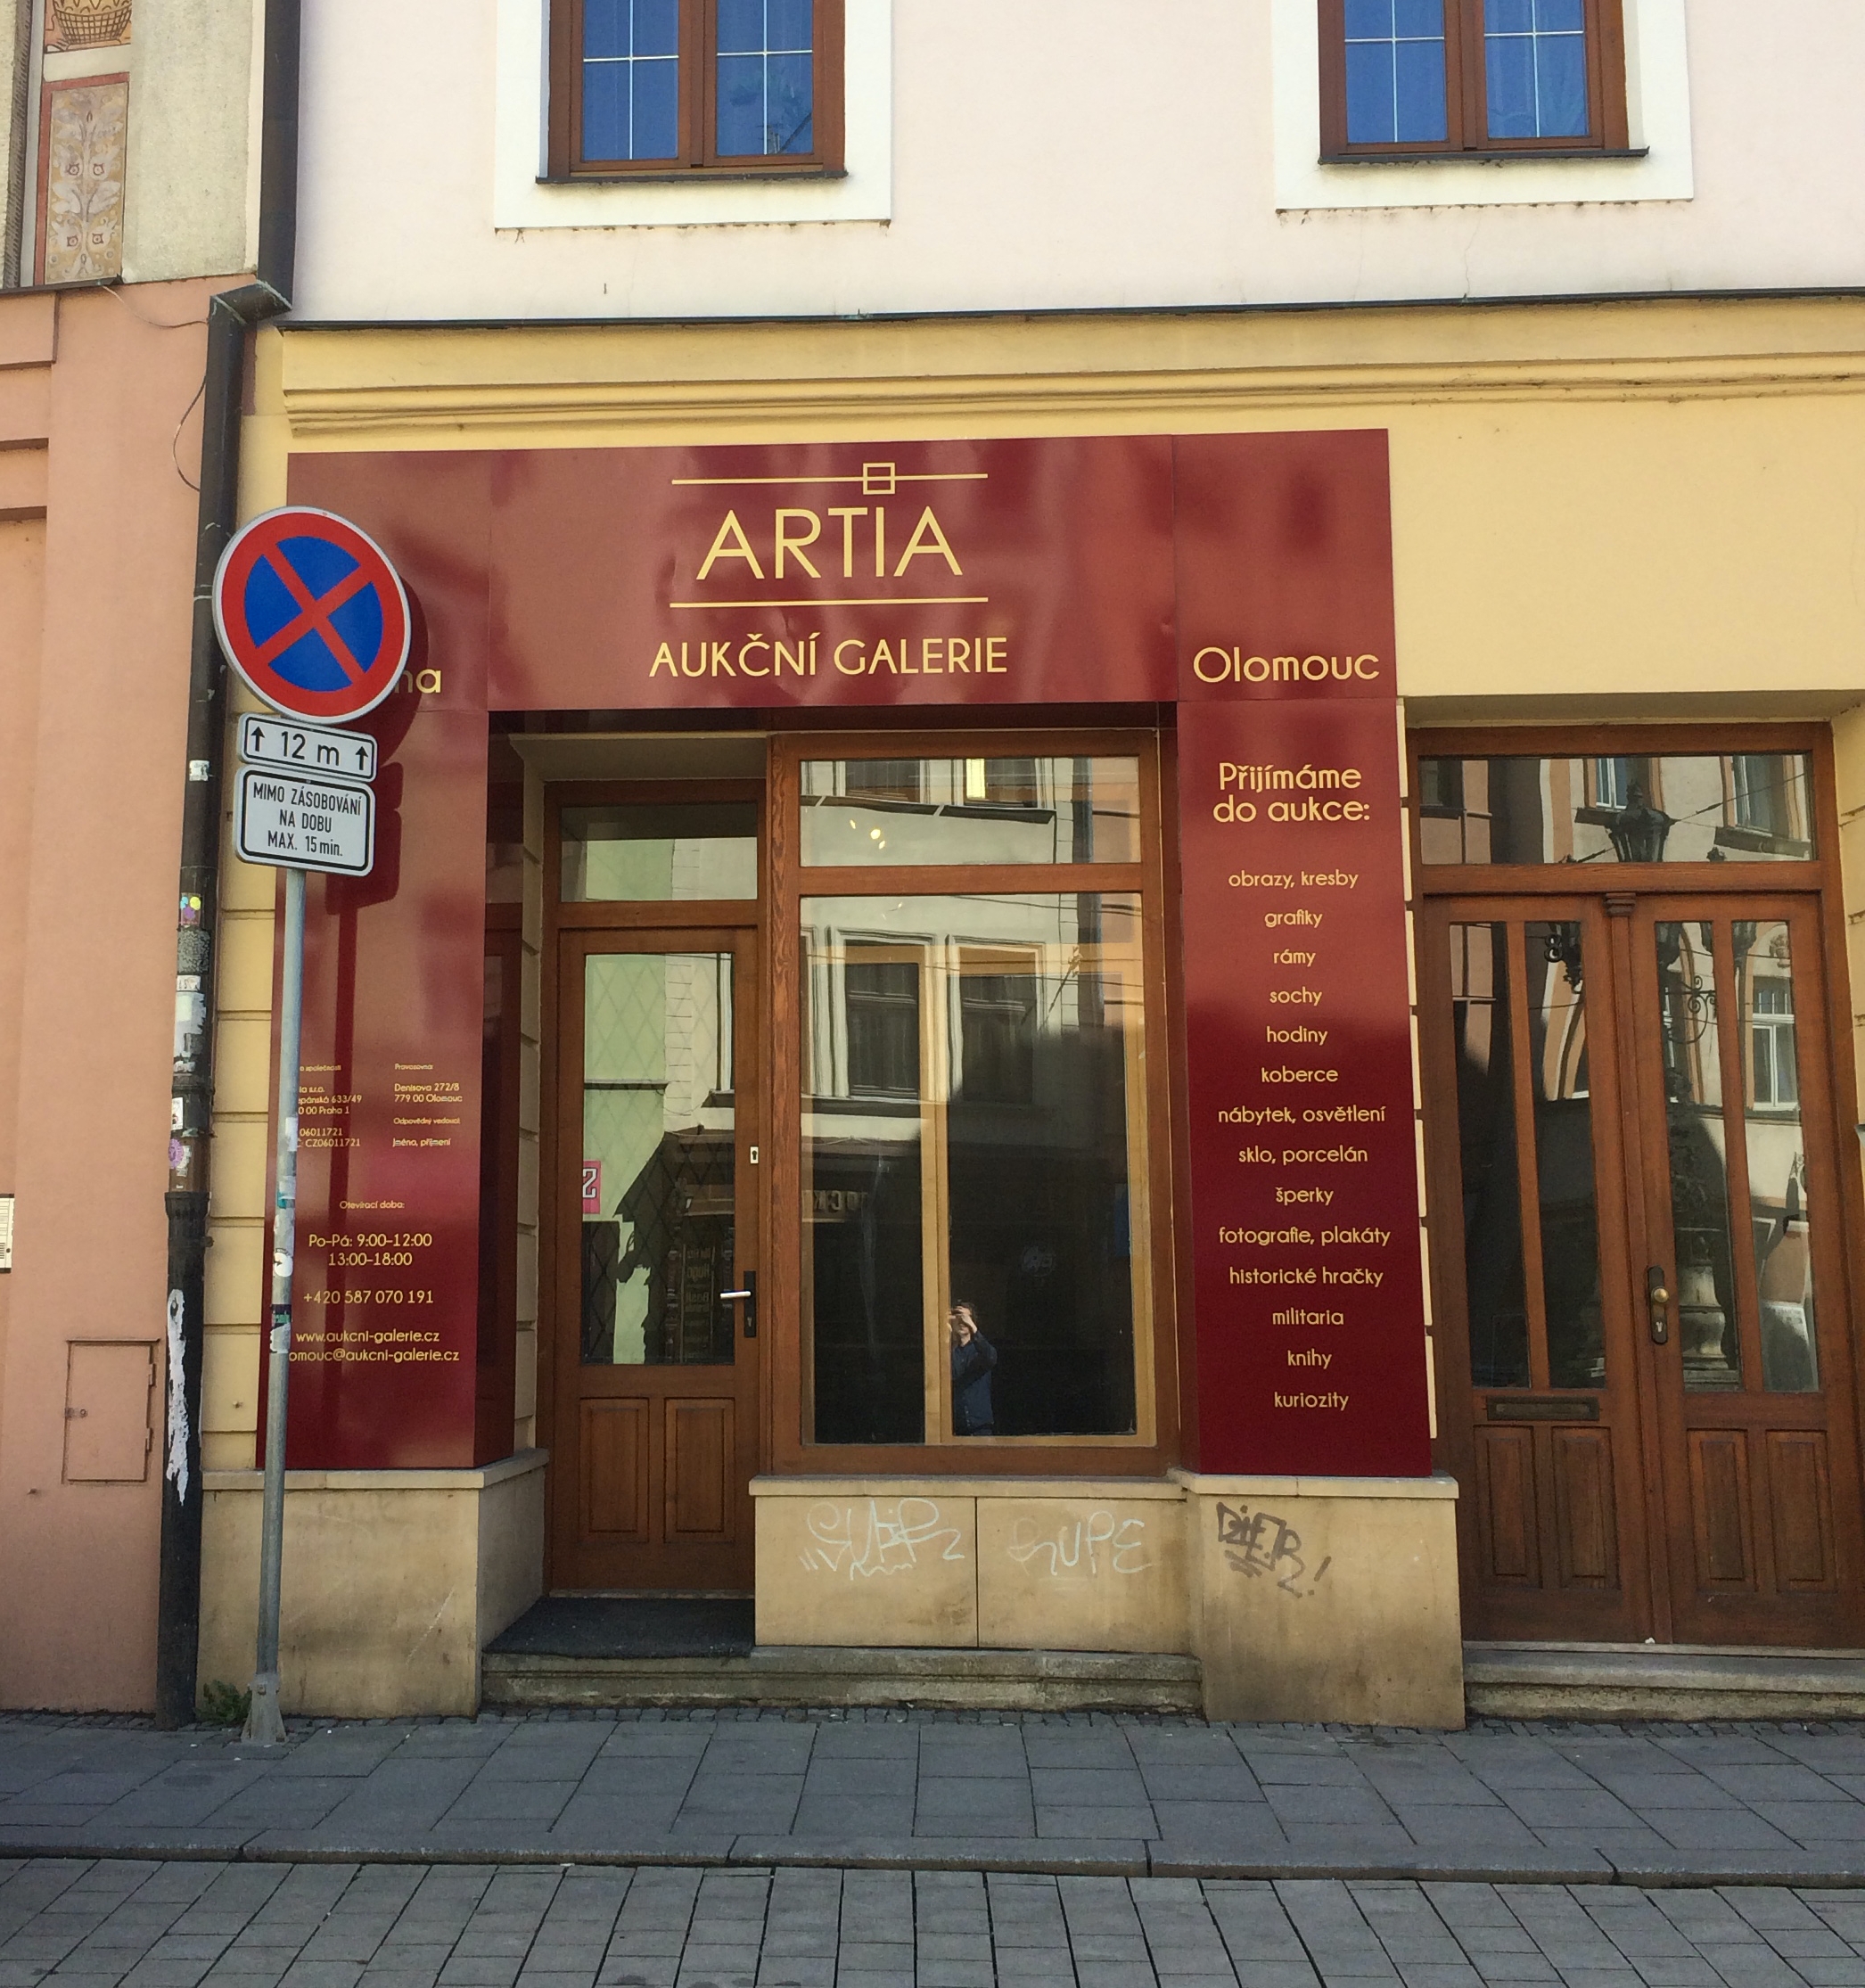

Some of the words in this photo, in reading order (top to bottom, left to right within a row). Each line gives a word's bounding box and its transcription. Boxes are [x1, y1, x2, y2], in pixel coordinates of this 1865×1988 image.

[695, 505, 964, 581] ARTIA
[648, 631, 821, 678] AUKČNÍ
[833, 636, 1008, 677] GALERIE
[1192, 646, 1381, 684] Olomouc
[281, 730, 306, 760] 12
[316, 743, 340, 767] m
[1219, 762, 1362, 793] Přijímáme
[253, 781, 285, 803] MIMO
[291, 785, 362, 816] ZÁSOBOVÁNÍ
[1212, 795, 1256, 823] do
[1267, 795, 1371, 822] aukce:
[279, 809, 296, 828] NA
[301, 812, 333, 834] DOBU
[267, 830, 298, 850] MAX.
[305, 835, 317, 853] 15
[319, 838, 343, 857] min.
[1228, 871, 1295, 889] obrazy,
[1301, 870, 1359, 889] kresby
[1264, 909, 1323, 928] grafiky
[1273, 949, 1317, 968] rámy
[1269, 987, 1323, 1006] sochy
[1266, 1026, 1328, 1046] hodiny
[1261, 1066, 1339, 1083] koberce
[394, 1083, 432, 1092] Denisova
[433, 1082, 460, 1092] 272/8
[331, 1094, 362, 1104] 633/49
[394, 1094, 411, 1103] 779
[412, 1094, 424, 1103] 00
[425, 1093, 463, 1103] Olomouc
[305, 1106, 317, 1114] 00
[318, 1106, 343, 1114] Praha
[344, 1105, 350, 1114] 1
[1218, 1106, 1297, 1125] nábytek,
[1302, 1105, 1386, 1123] osvětlení
[299, 1128, 343, 1137] 06011721
[305, 1138, 361, 1148] CZ06011721
[1238, 1146, 1277, 1164] sklo,
[1282, 1146, 1368, 1163] porcelán
[339, 1200, 378, 1210] Otevírací
[379, 1200, 406, 1209] doba:
[1275, 1187, 1335, 1206] šperky
[308, 1234, 353, 1247] Po-Pá:
[357, 1233, 433, 1247] 9:00-12:00
[1218, 1226, 1315, 1245] fotografie,
[1320, 1226, 1392, 1246] plakáty
[328, 1252, 413, 1267] 13:00-18:00
[1229, 1267, 1318, 1285] historické
[1322, 1267, 1384, 1287] hračky
[303, 1290, 341, 1304] +420
[344, 1290, 372, 1304] 587
[374, 1290, 404, 1304] 070
[407, 1290, 434, 1304] 191
[1272, 1307, 1344, 1326] militaria
[295, 1327, 440, 1344] www.aukcni-galerie.cz
[289, 1347, 460, 1364] omouc@aukcni-galerie.cz
[1286, 1348, 1333, 1369] knihy
[1274, 1392, 1350, 1411] kuriozity
